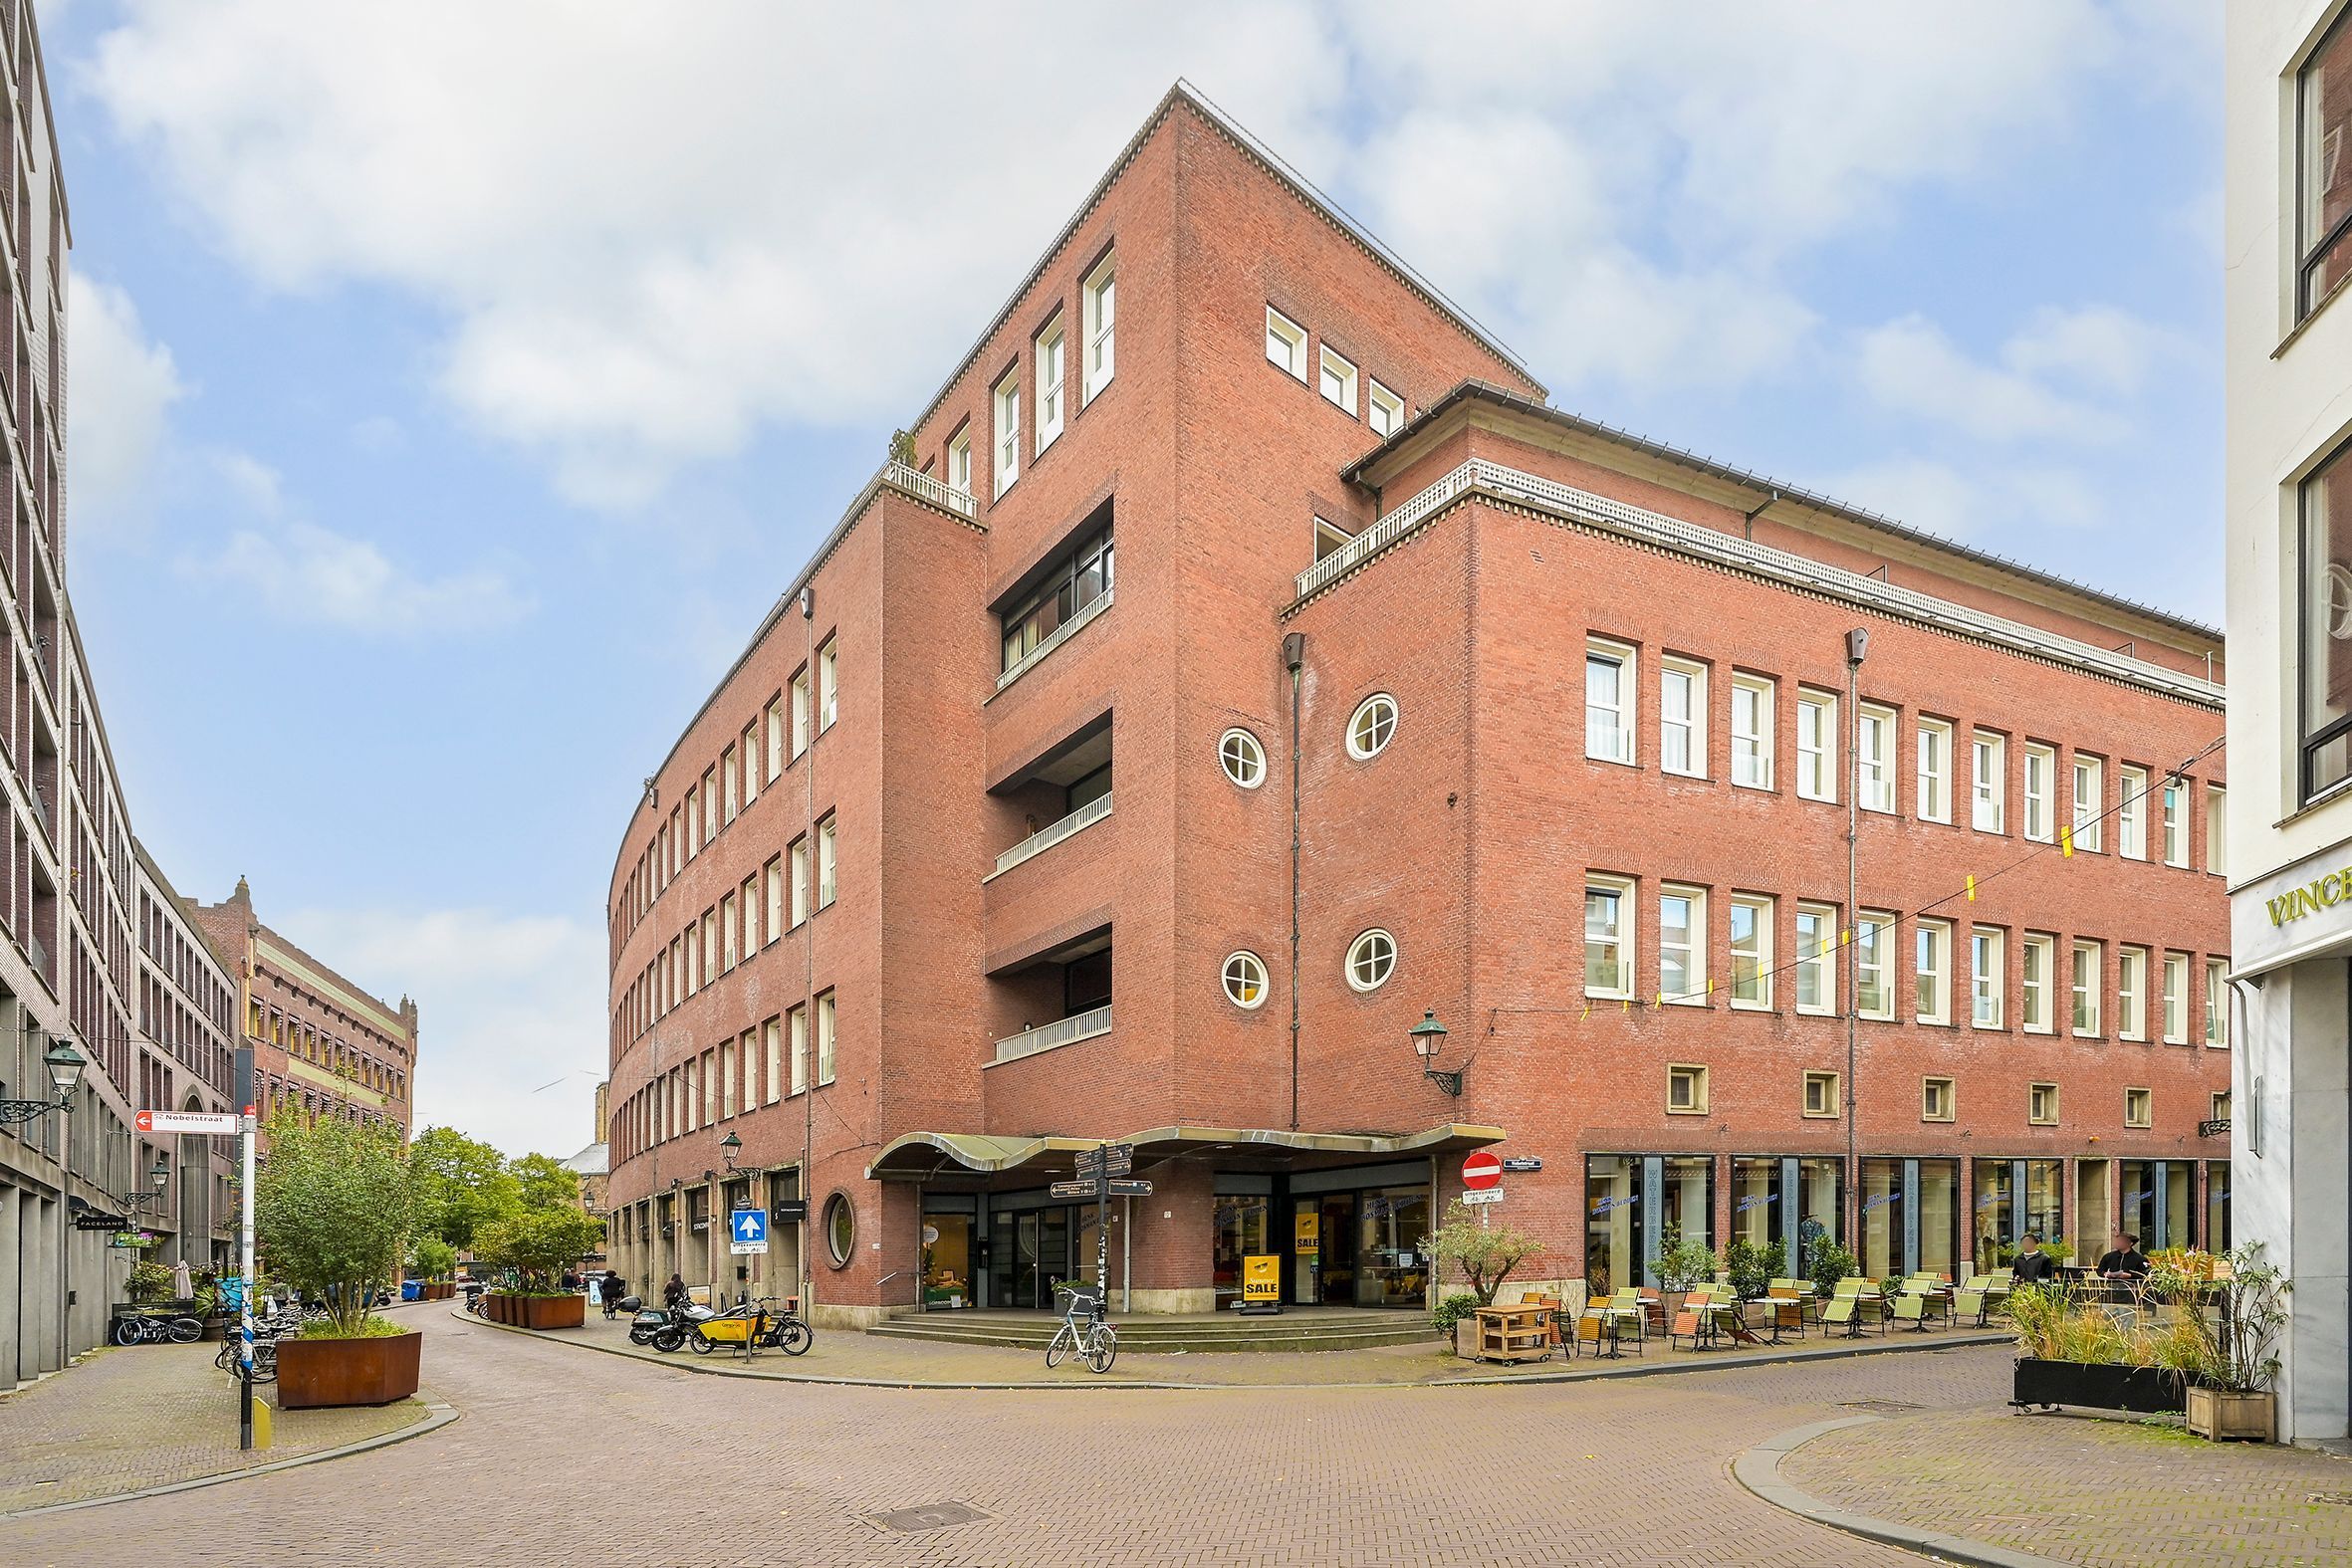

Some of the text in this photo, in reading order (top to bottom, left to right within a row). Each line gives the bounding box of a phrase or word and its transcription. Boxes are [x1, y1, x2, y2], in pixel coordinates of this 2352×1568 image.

[165, 1114, 223, 1123] Nobelstraat
[1297, 1238, 1318, 1247] SALE
[1246, 1283, 1278, 1293] SALE
